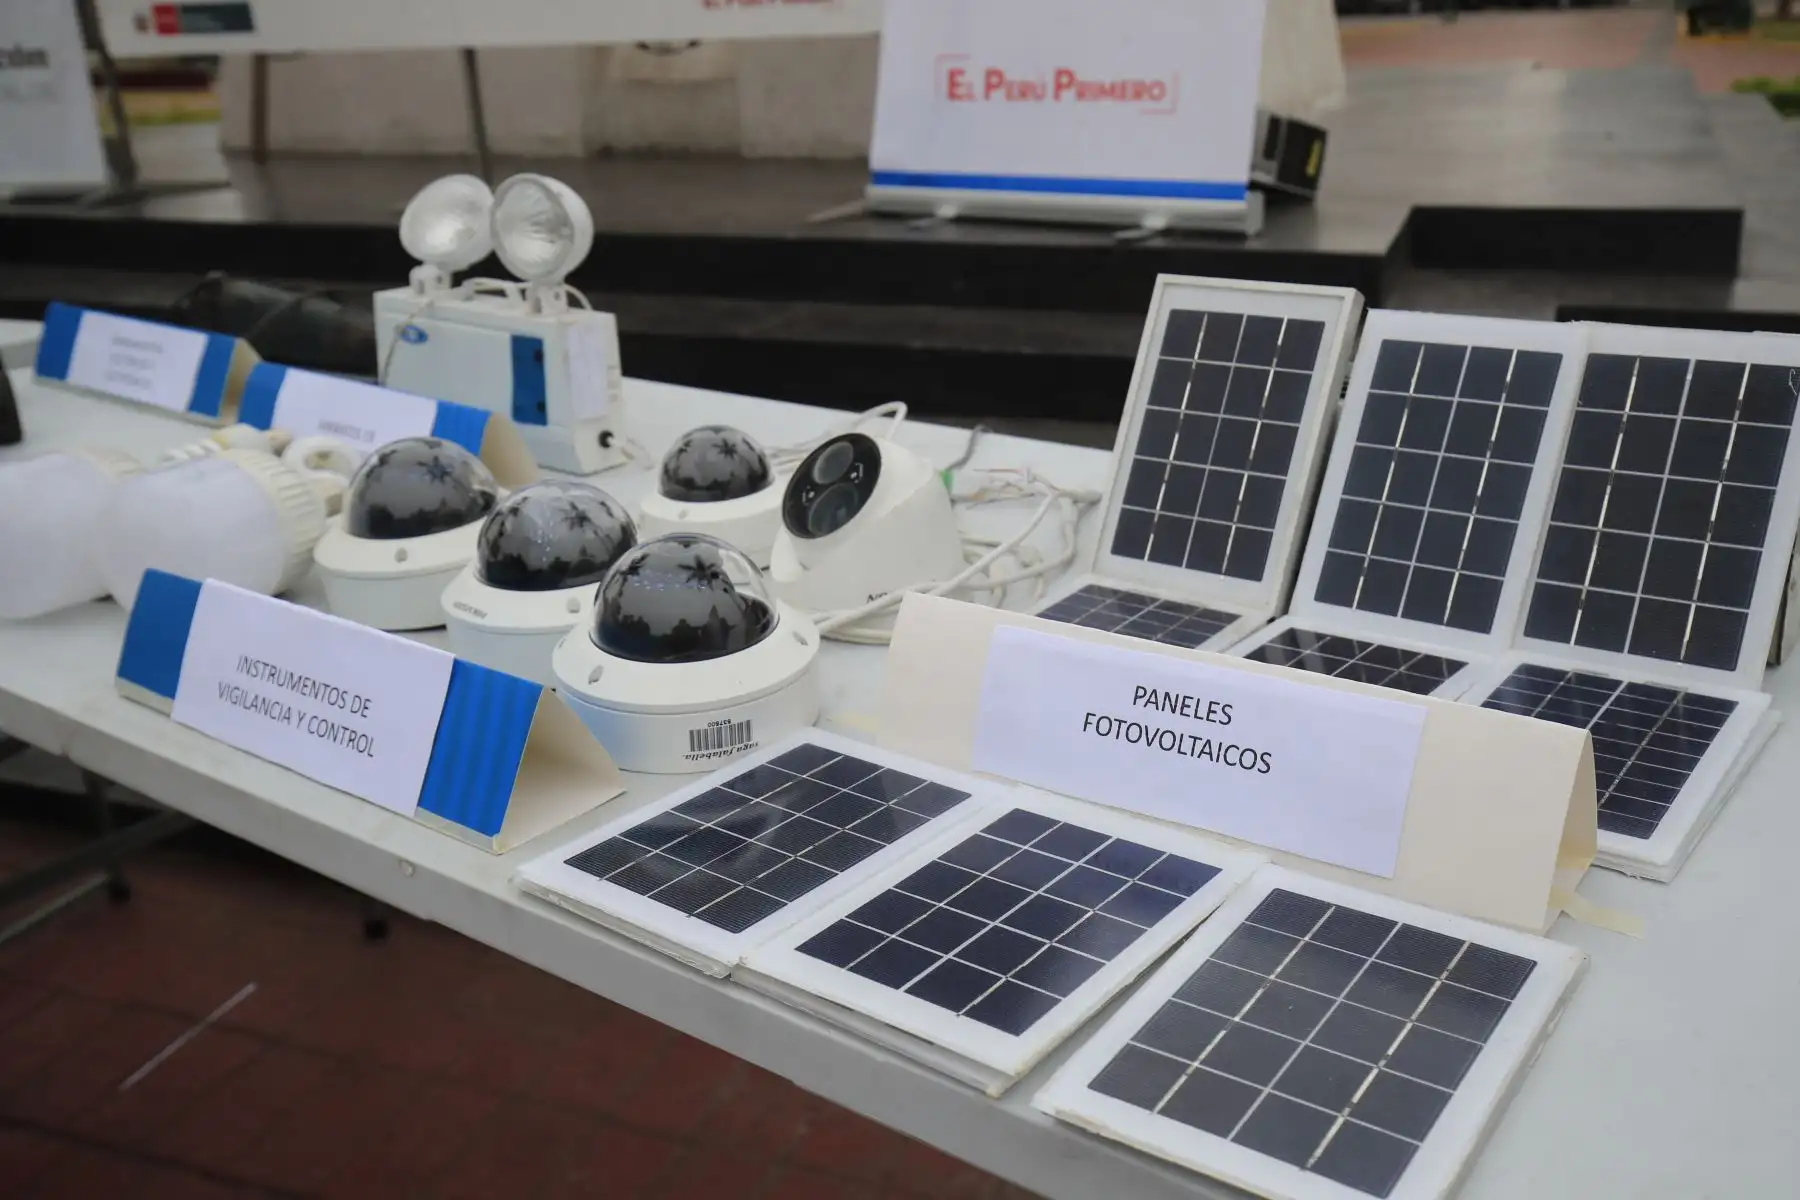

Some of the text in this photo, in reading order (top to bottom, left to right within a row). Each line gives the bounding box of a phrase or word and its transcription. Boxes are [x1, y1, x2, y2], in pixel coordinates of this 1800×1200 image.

[1053, 66, 1168, 102] PRIMERO
[218, 680, 376, 758] VIGILANCIA Y CONTROL
[236, 655, 373, 719] INSTRUMENTOS DE
[1133, 685, 1234, 726] PANELES
[1083, 711, 1273, 775] FOTOVOLTAICOS
